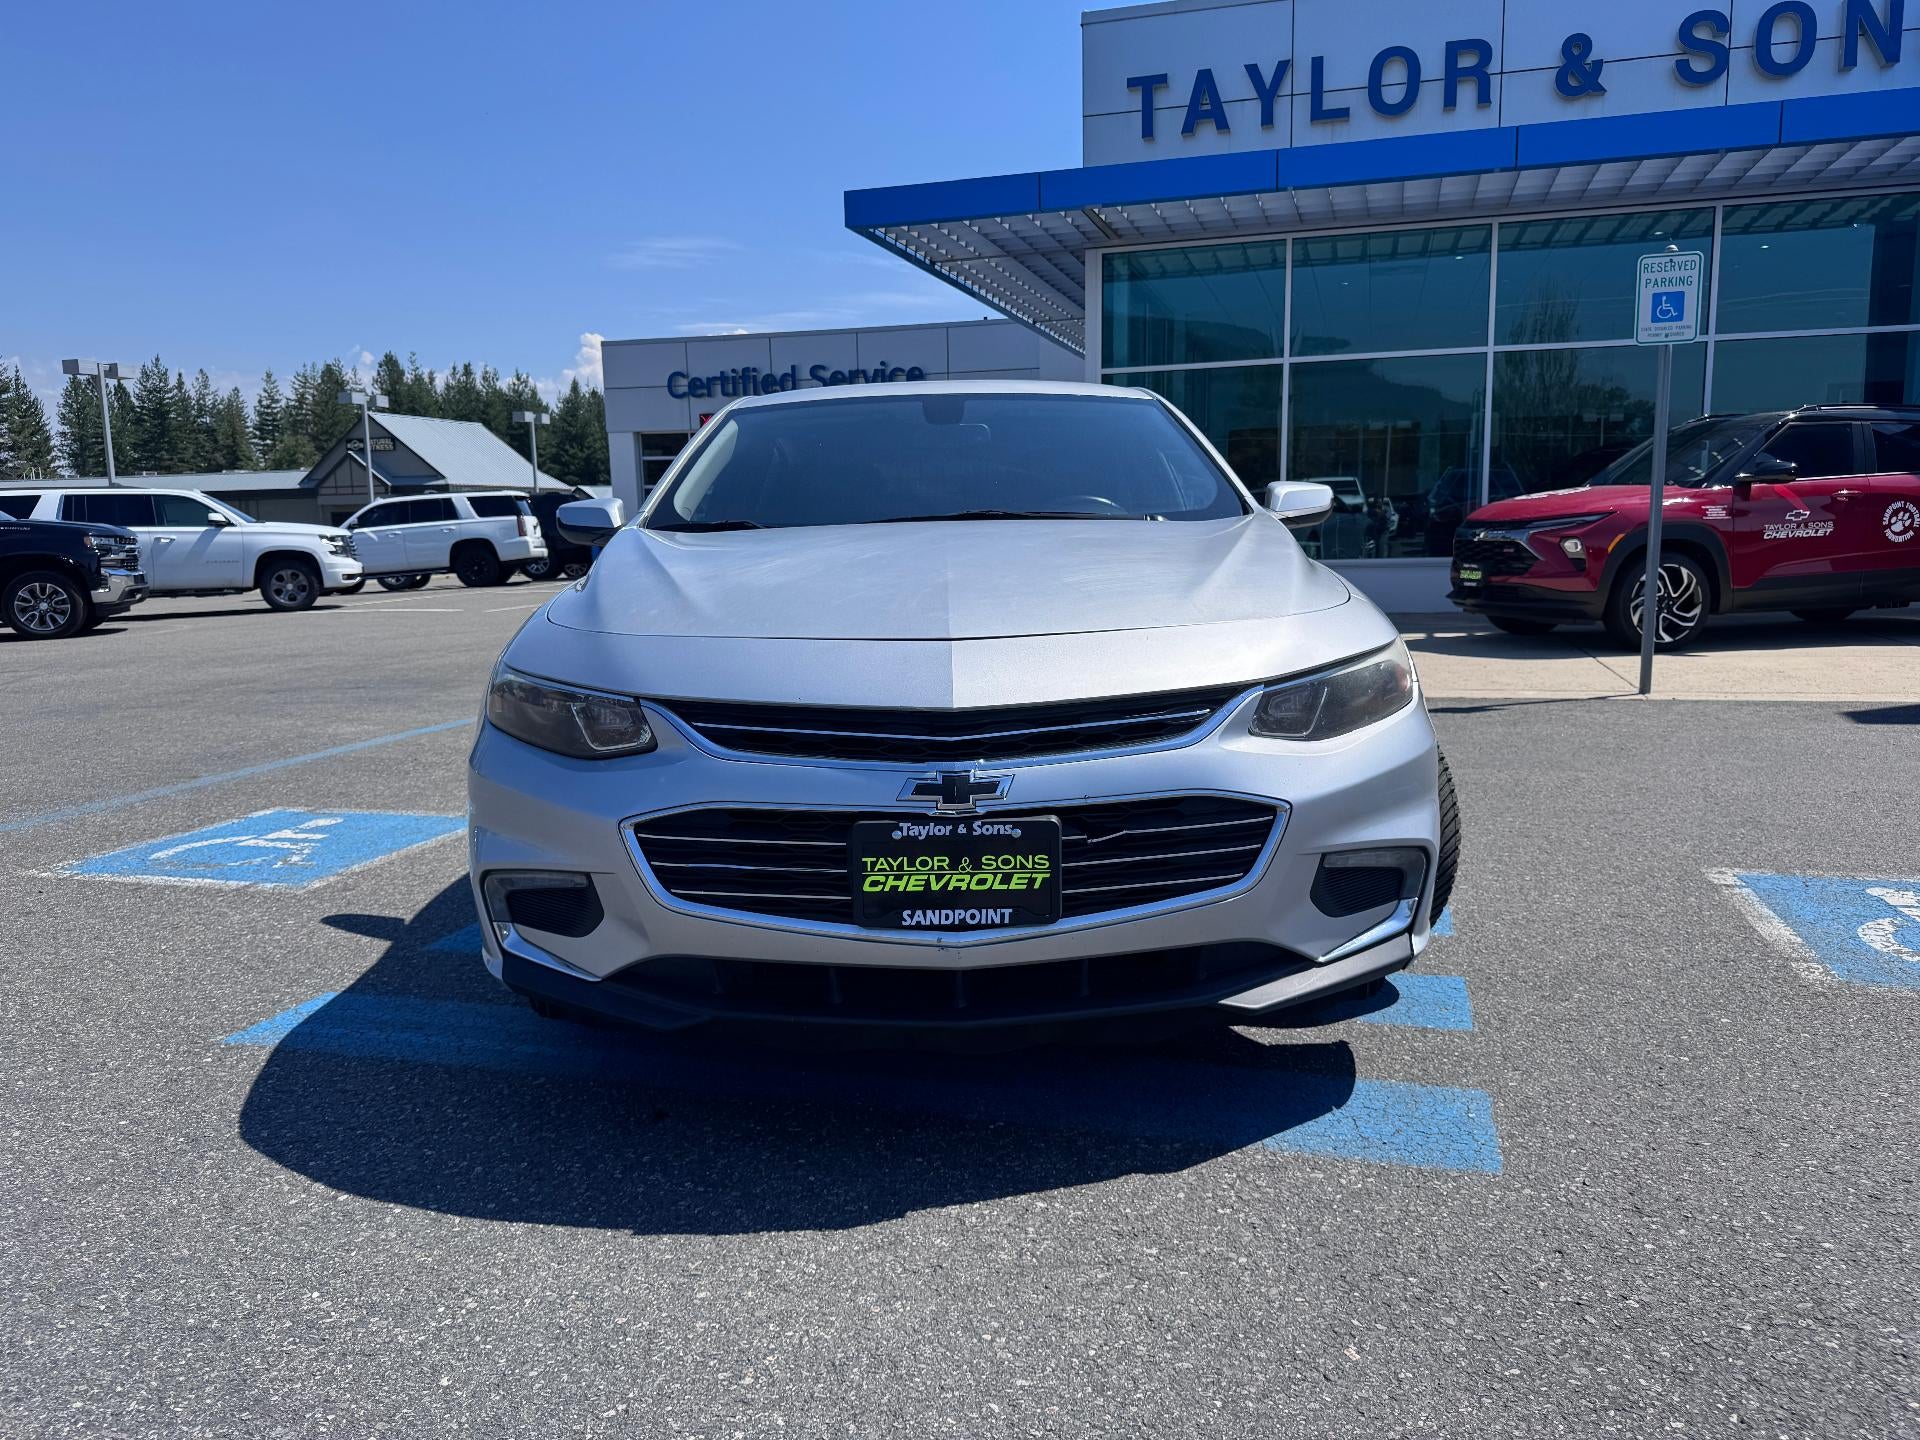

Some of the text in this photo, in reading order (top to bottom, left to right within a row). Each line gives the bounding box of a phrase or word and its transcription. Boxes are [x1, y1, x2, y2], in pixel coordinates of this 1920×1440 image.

[1127, 0, 1904, 140] TAYLOR & SON
[1643, 260, 1696, 273] RESERVED
[1645, 276, 1693, 288] PARKING
[667, 361, 925, 399] Certified Service
[1763, 528, 1834, 539] CHEVROLET
[1764, 523, 1797, 531] TAYLOR
[1808, 521, 1834, 529] SONS
[900, 821, 1012, 840] Taylor & Sons
[862, 855, 1050, 873] TAYLOR & SONS
[862, 873, 1050, 892] CHEVROLET
[902, 909, 1012, 926] SANDPOINT
